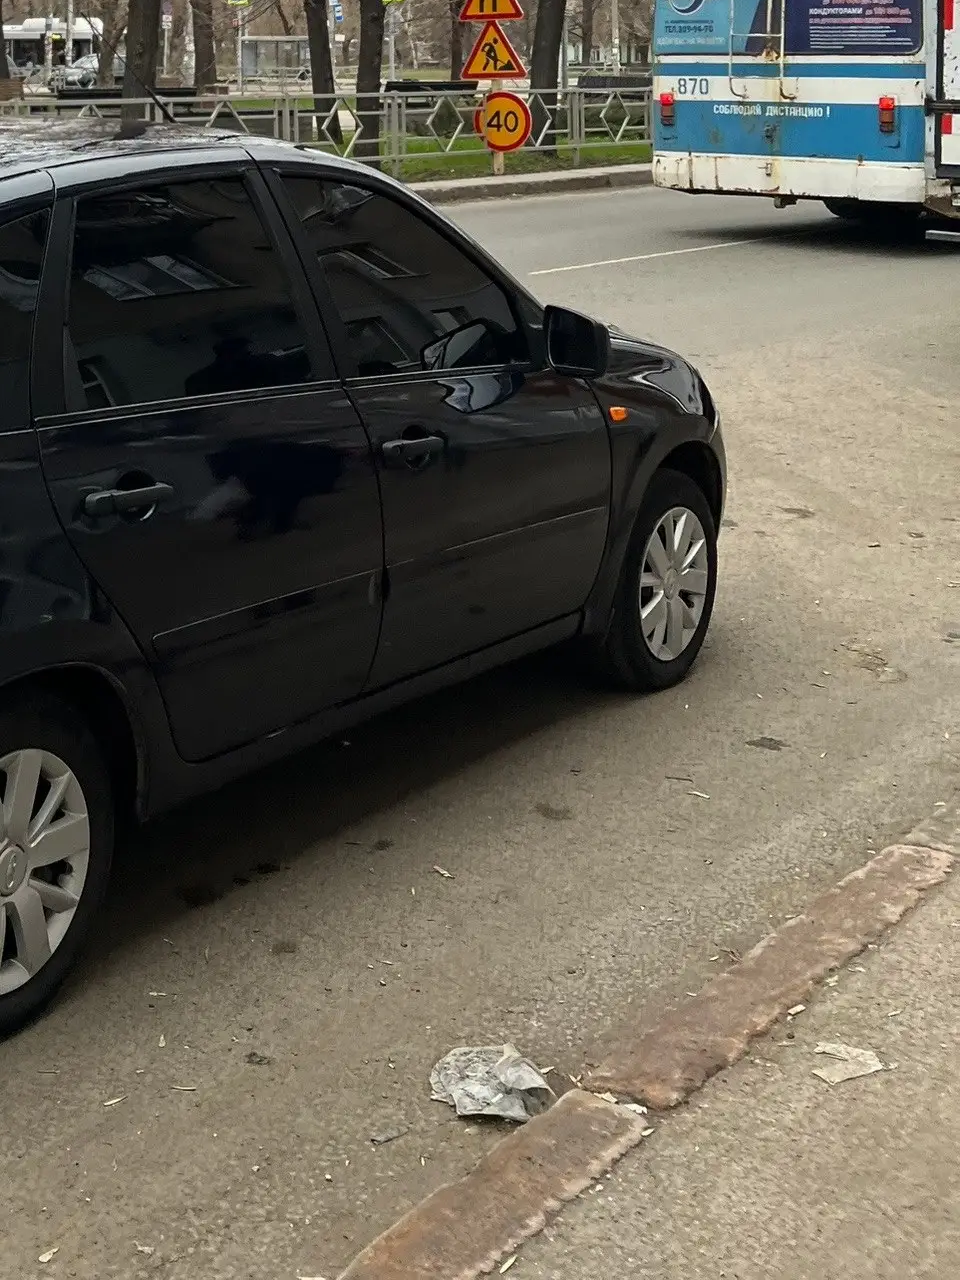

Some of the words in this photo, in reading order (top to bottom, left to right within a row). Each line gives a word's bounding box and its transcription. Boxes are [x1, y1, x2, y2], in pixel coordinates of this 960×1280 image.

[678, 78, 709, 95] 870
[713, 104, 761, 115] СОБЛЮДАЙ
[765, 106, 823, 118] ДИСТАНЦИЮ
[486, 110, 519, 132] 40
